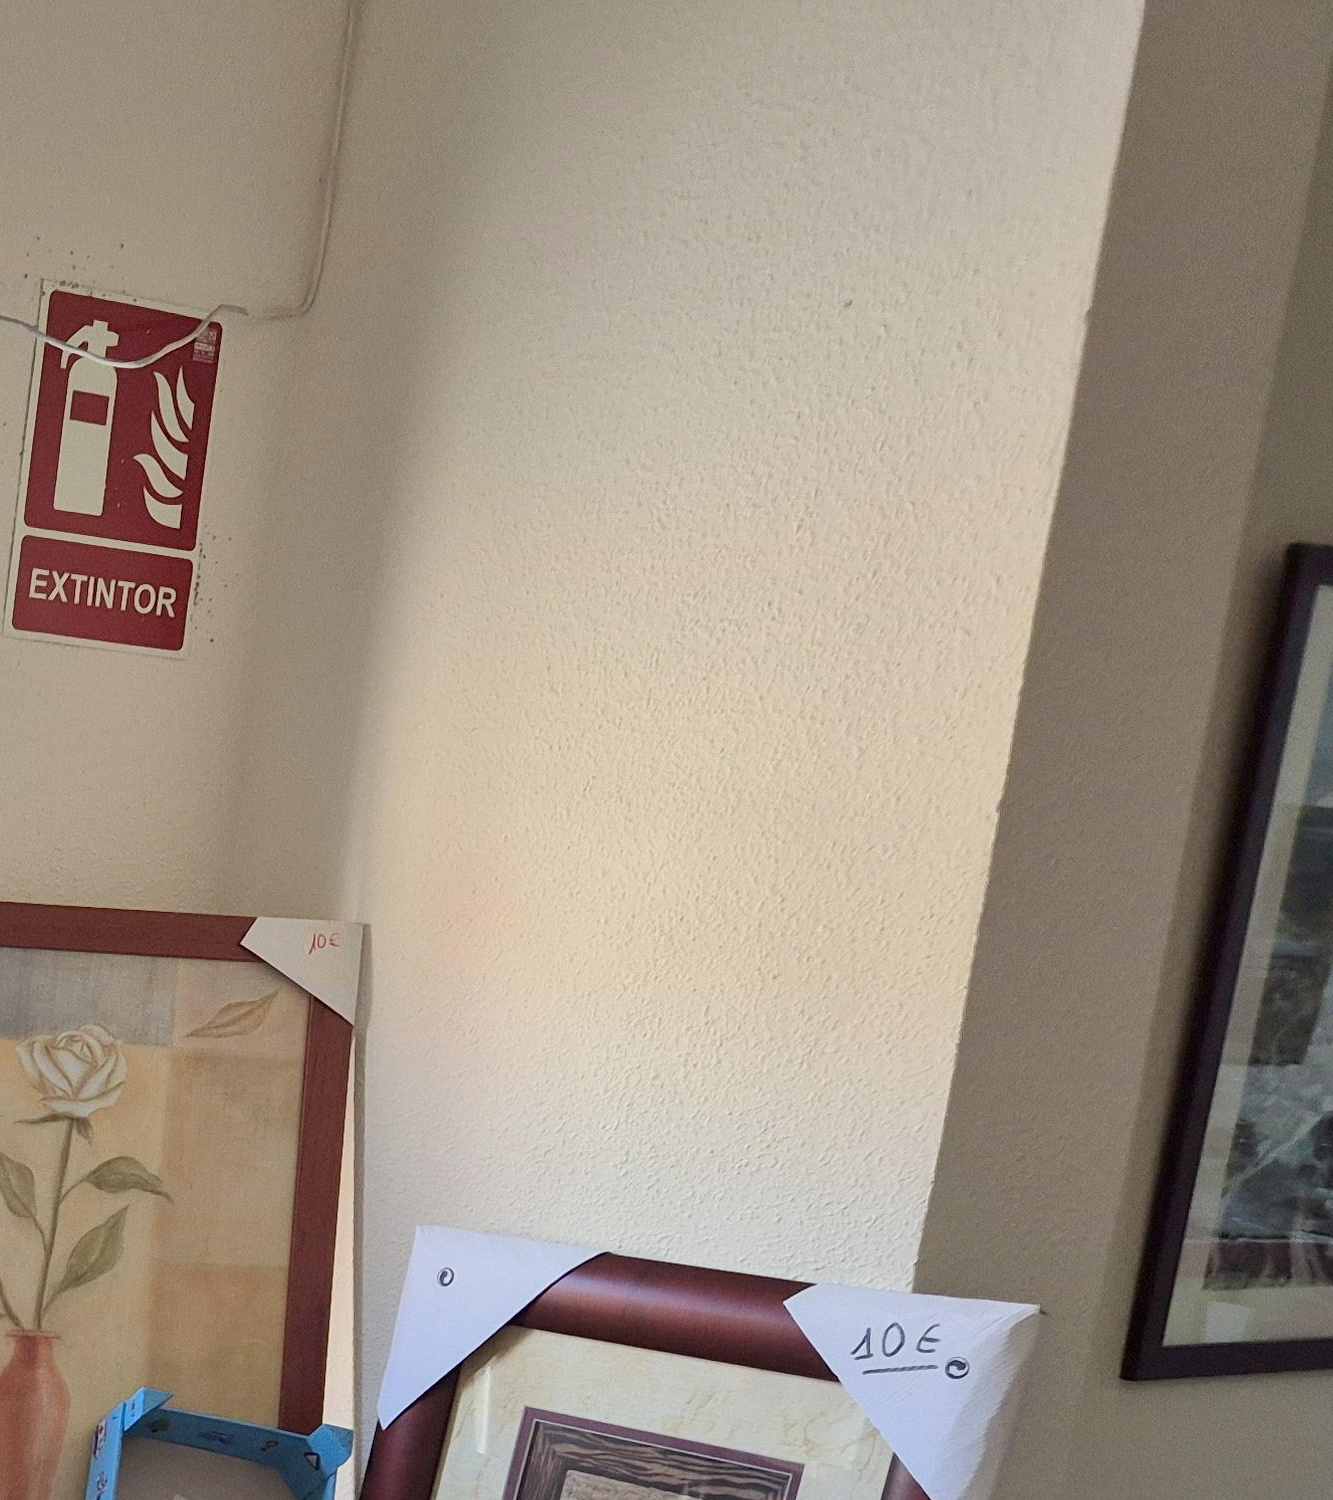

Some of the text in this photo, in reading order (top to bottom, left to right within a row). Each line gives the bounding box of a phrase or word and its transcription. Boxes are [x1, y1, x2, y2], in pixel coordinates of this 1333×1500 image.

[28, 567, 177, 618] EXTINTOR
[308, 933, 340, 955] 10€
[850, 1321, 941, 1361] 10€
